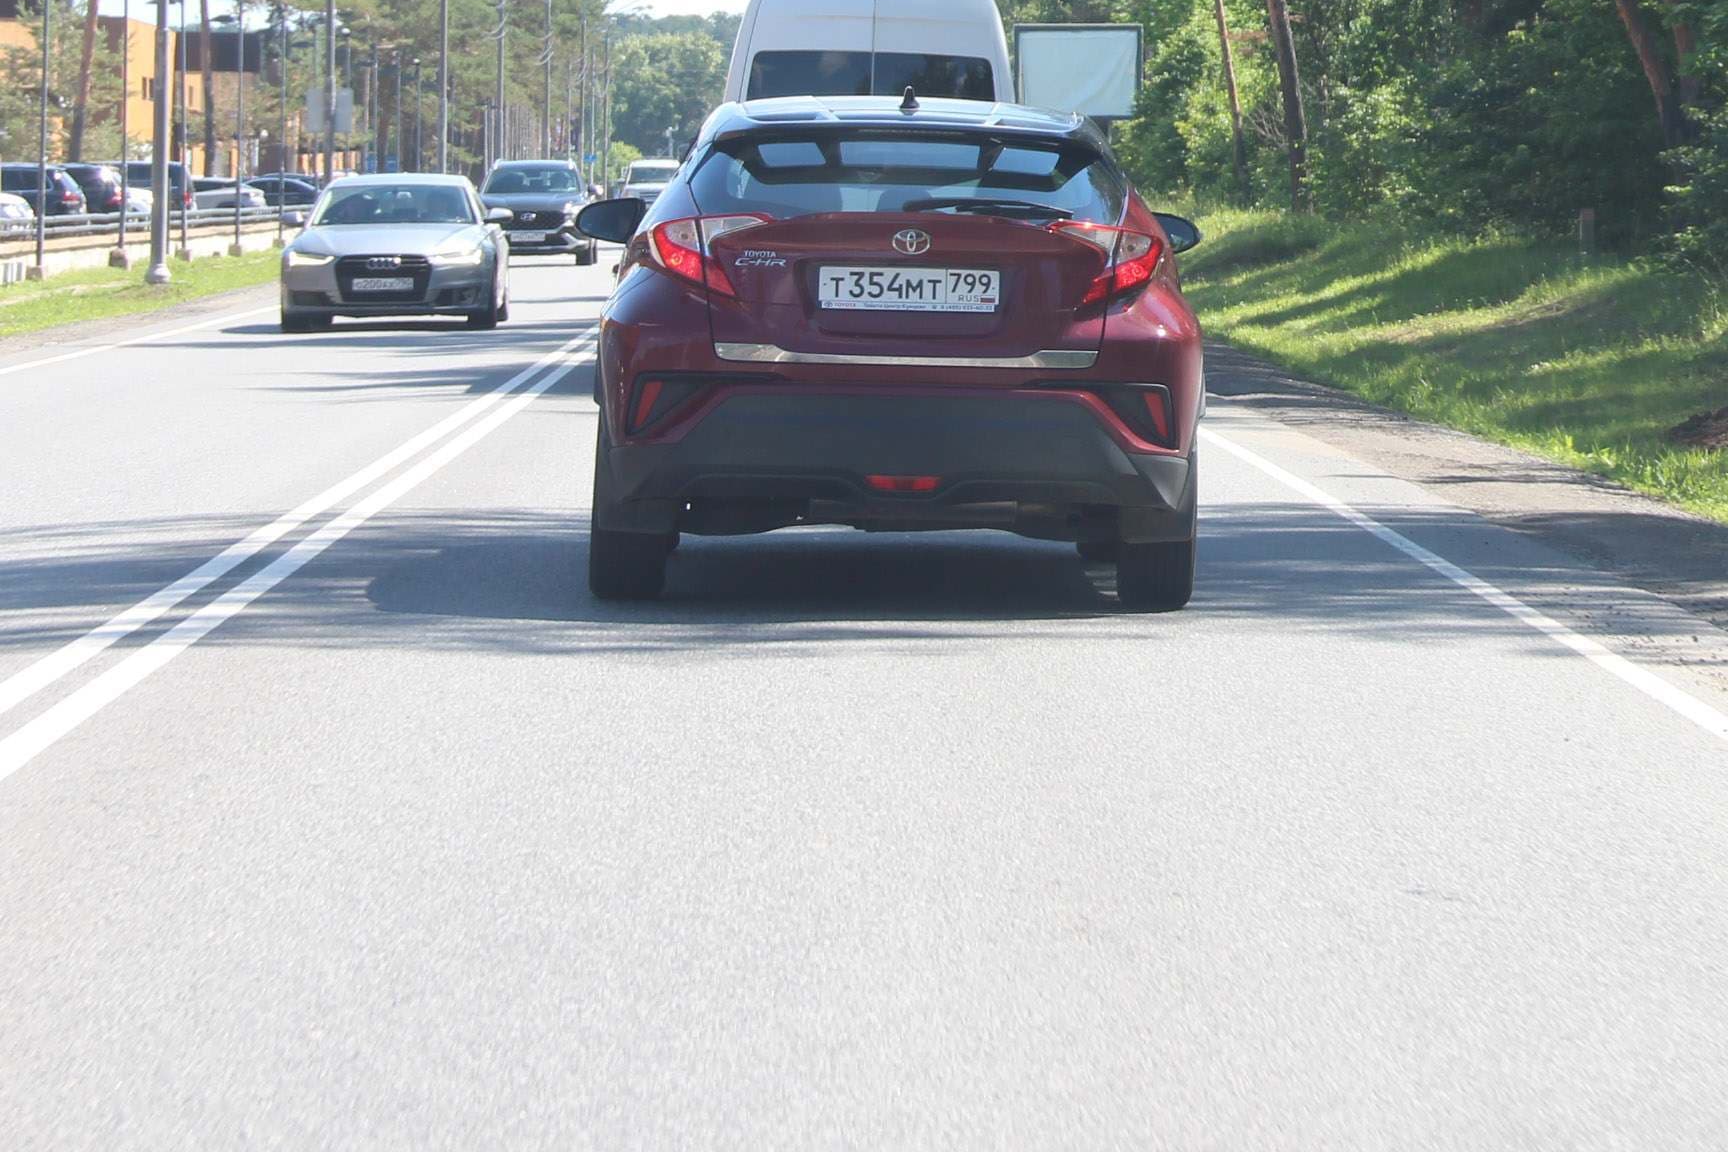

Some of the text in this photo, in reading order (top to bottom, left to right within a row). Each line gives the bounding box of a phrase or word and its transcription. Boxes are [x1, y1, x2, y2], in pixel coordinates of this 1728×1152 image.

[743, 250, 777, 258] TOYOTA
[735, 257, 786, 267] C-HR
[949, 272, 992, 294] 799
[957, 294, 980, 303] RUS
